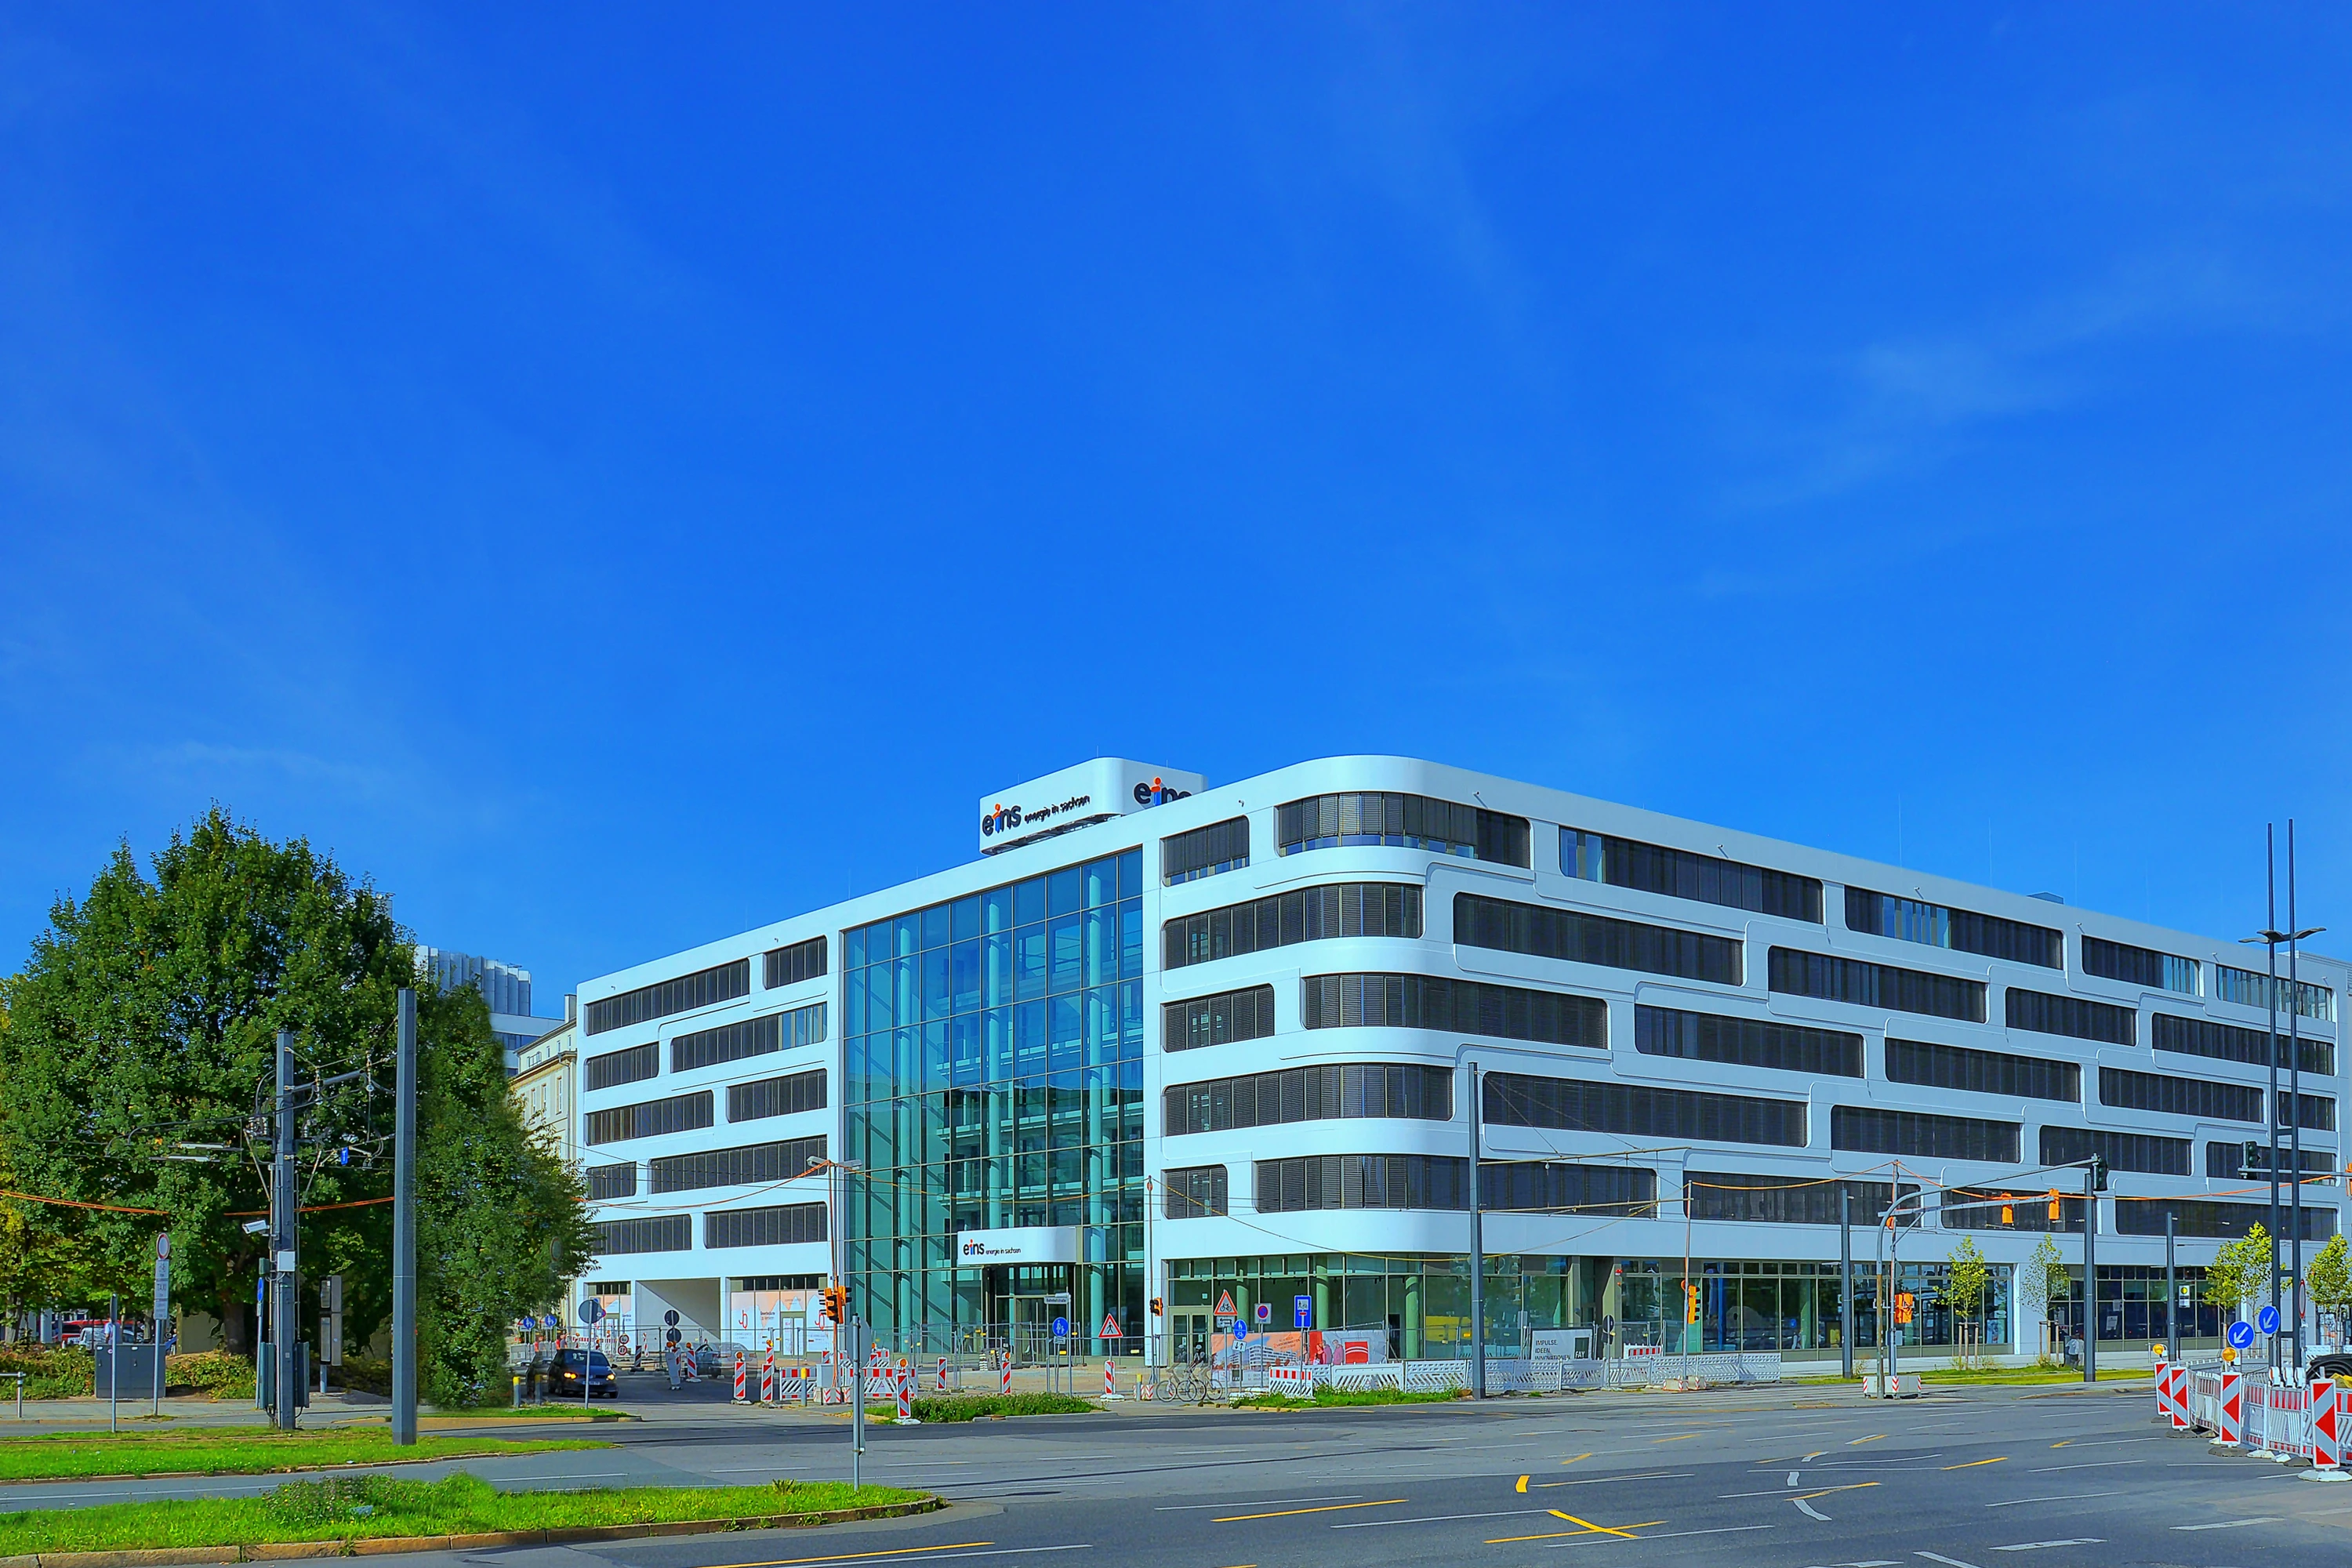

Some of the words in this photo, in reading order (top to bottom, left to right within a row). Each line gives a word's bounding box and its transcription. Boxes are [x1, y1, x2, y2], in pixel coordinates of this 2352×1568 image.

[1134, 777, 1192, 806] ein
[982, 803, 1022, 837] eins
[1051, 804, 1059, 815] in
[963, 1239, 985, 1256] eins
